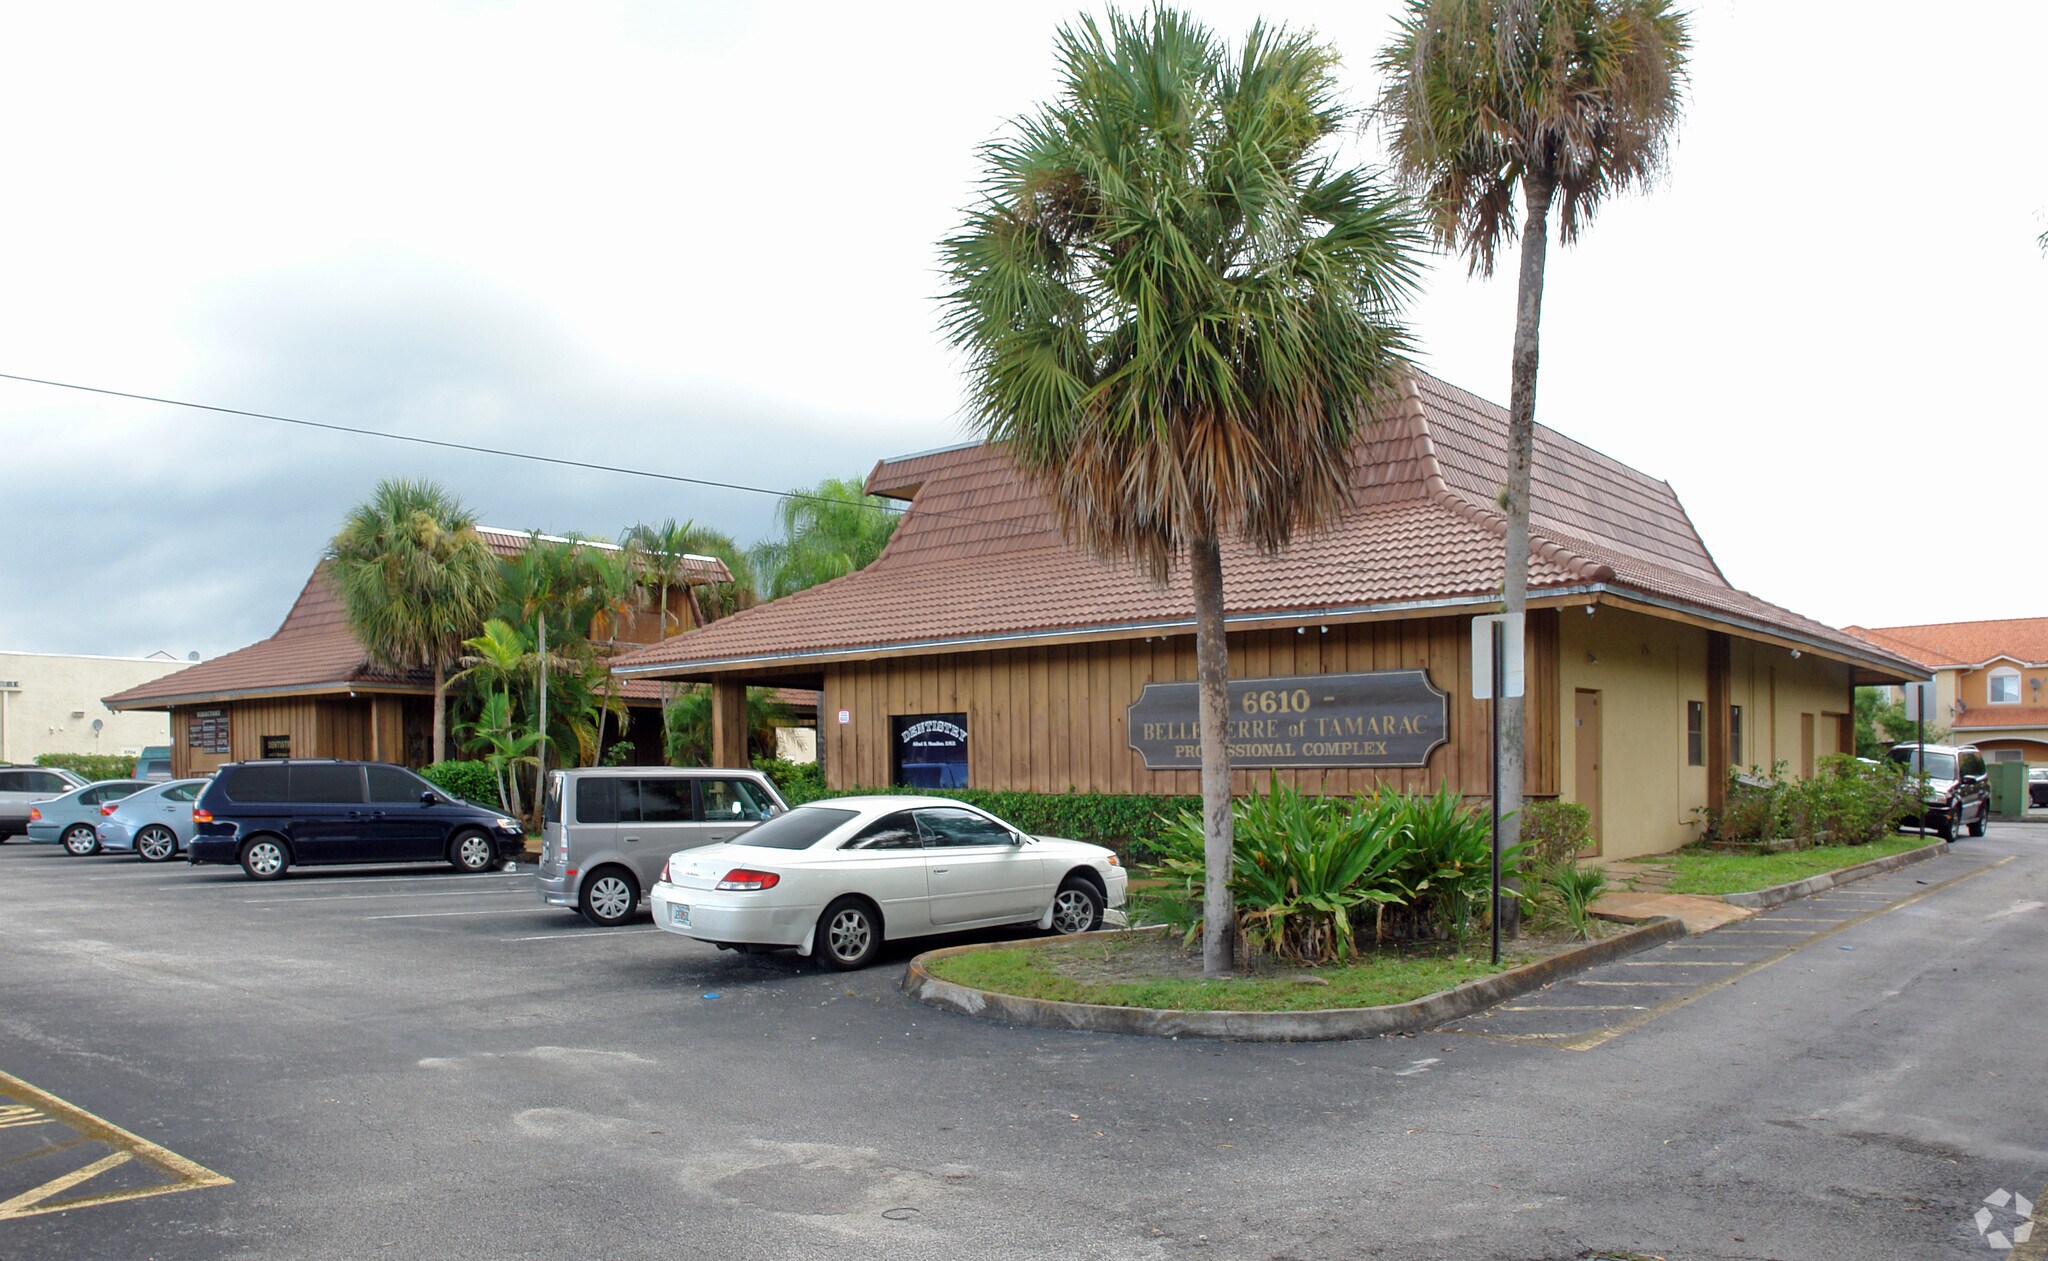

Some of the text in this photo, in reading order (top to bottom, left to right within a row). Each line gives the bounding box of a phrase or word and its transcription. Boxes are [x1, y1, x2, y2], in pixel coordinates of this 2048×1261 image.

[1241, 689, 1311, 714] 6610
[901, 720, 968, 743] DENTISTRY
[1143, 714, 1428, 741] BELLE ERRE of TAMARAC
[1175, 741, 1388, 758] PROSSIONAL COMPLEX
